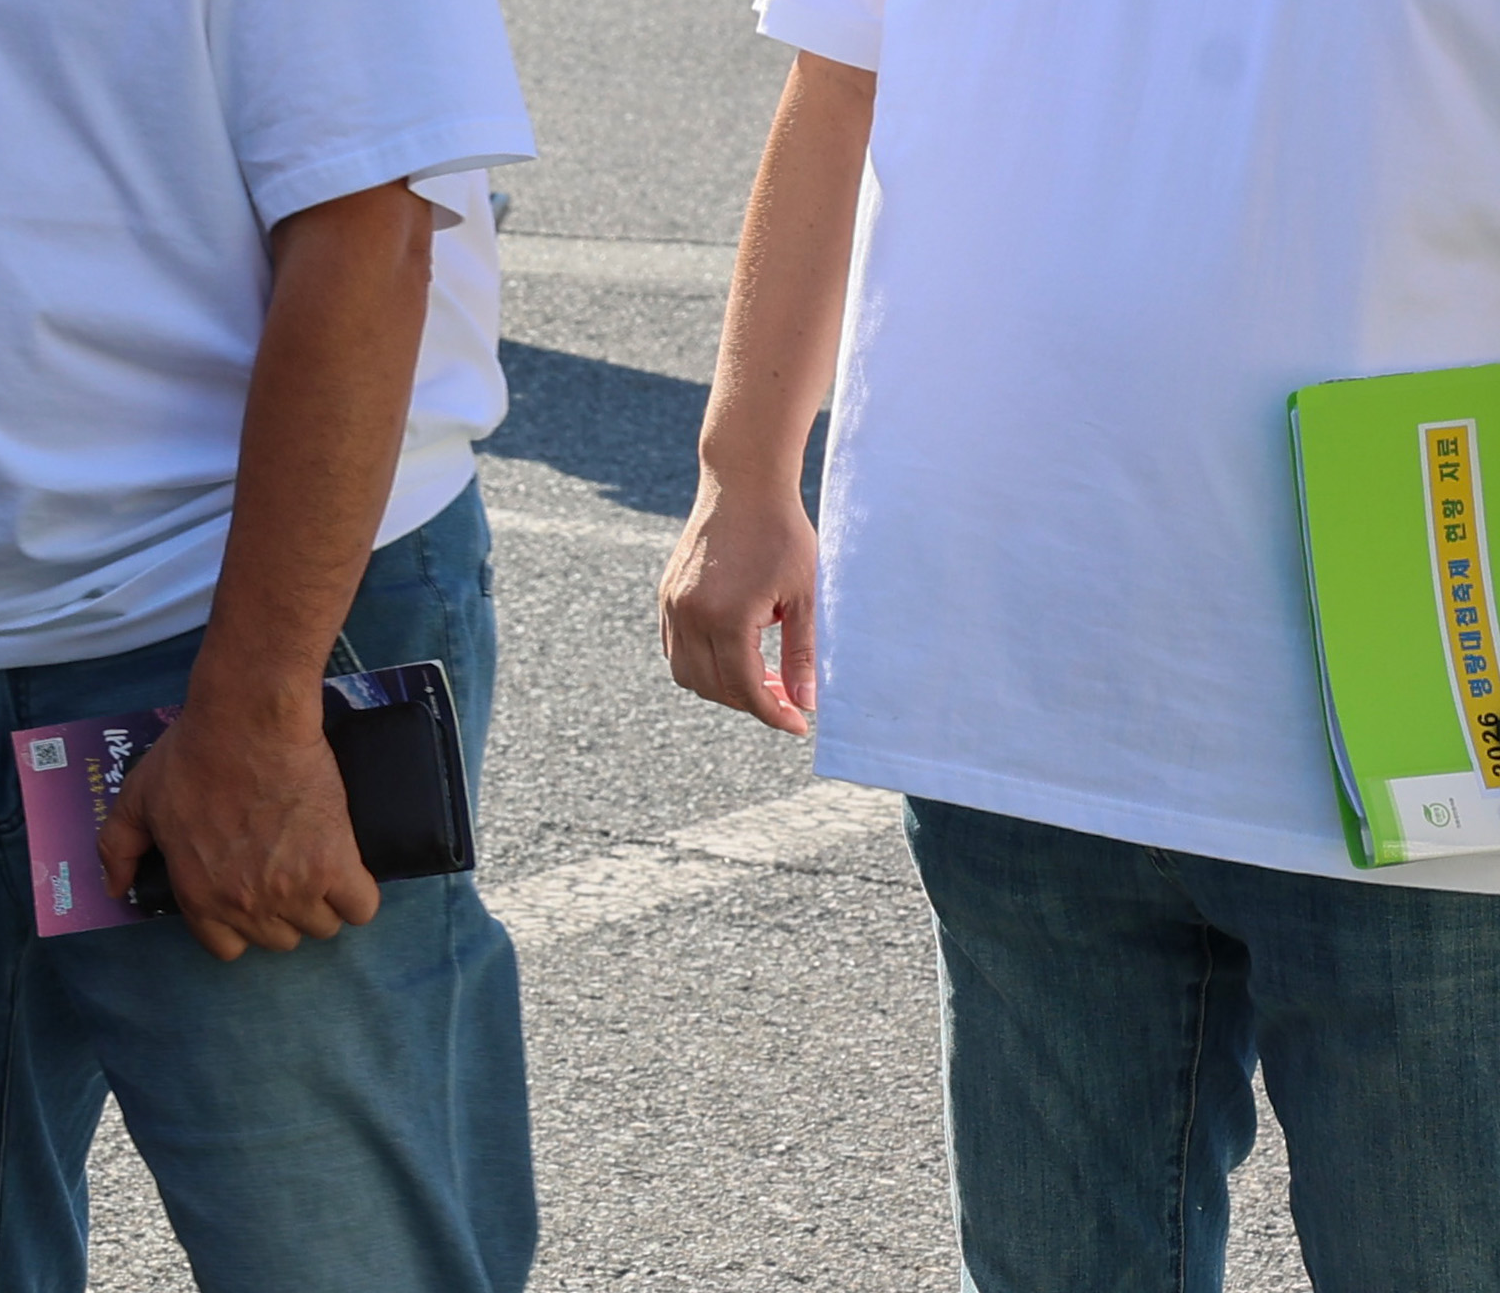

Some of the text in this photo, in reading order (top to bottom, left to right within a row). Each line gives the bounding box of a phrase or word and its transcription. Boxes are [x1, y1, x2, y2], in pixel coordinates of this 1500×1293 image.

[1436, 436, 1462, 483] 자료
[1441, 497, 1469, 545] 현황
[1446, 558, 1494, 700] 명량대첩축제
